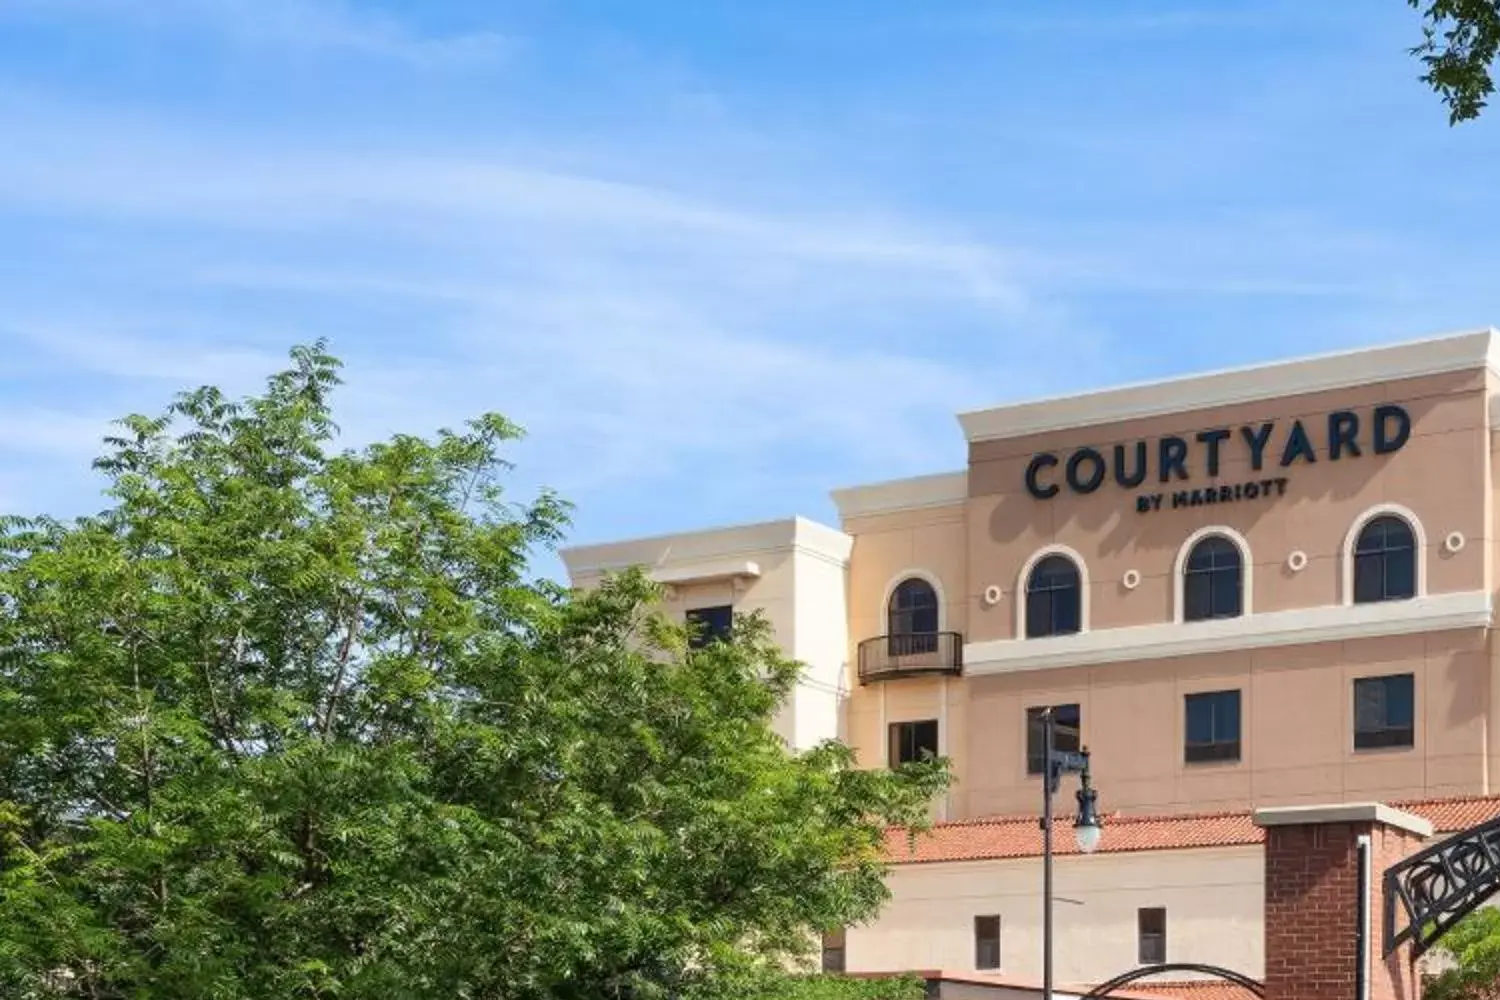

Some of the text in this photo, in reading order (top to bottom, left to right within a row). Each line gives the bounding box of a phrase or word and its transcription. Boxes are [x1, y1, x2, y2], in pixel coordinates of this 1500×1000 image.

[1025, 405, 1411, 499] COURTYARD
[1136, 478, 1289, 513] BY MARRIOTT
